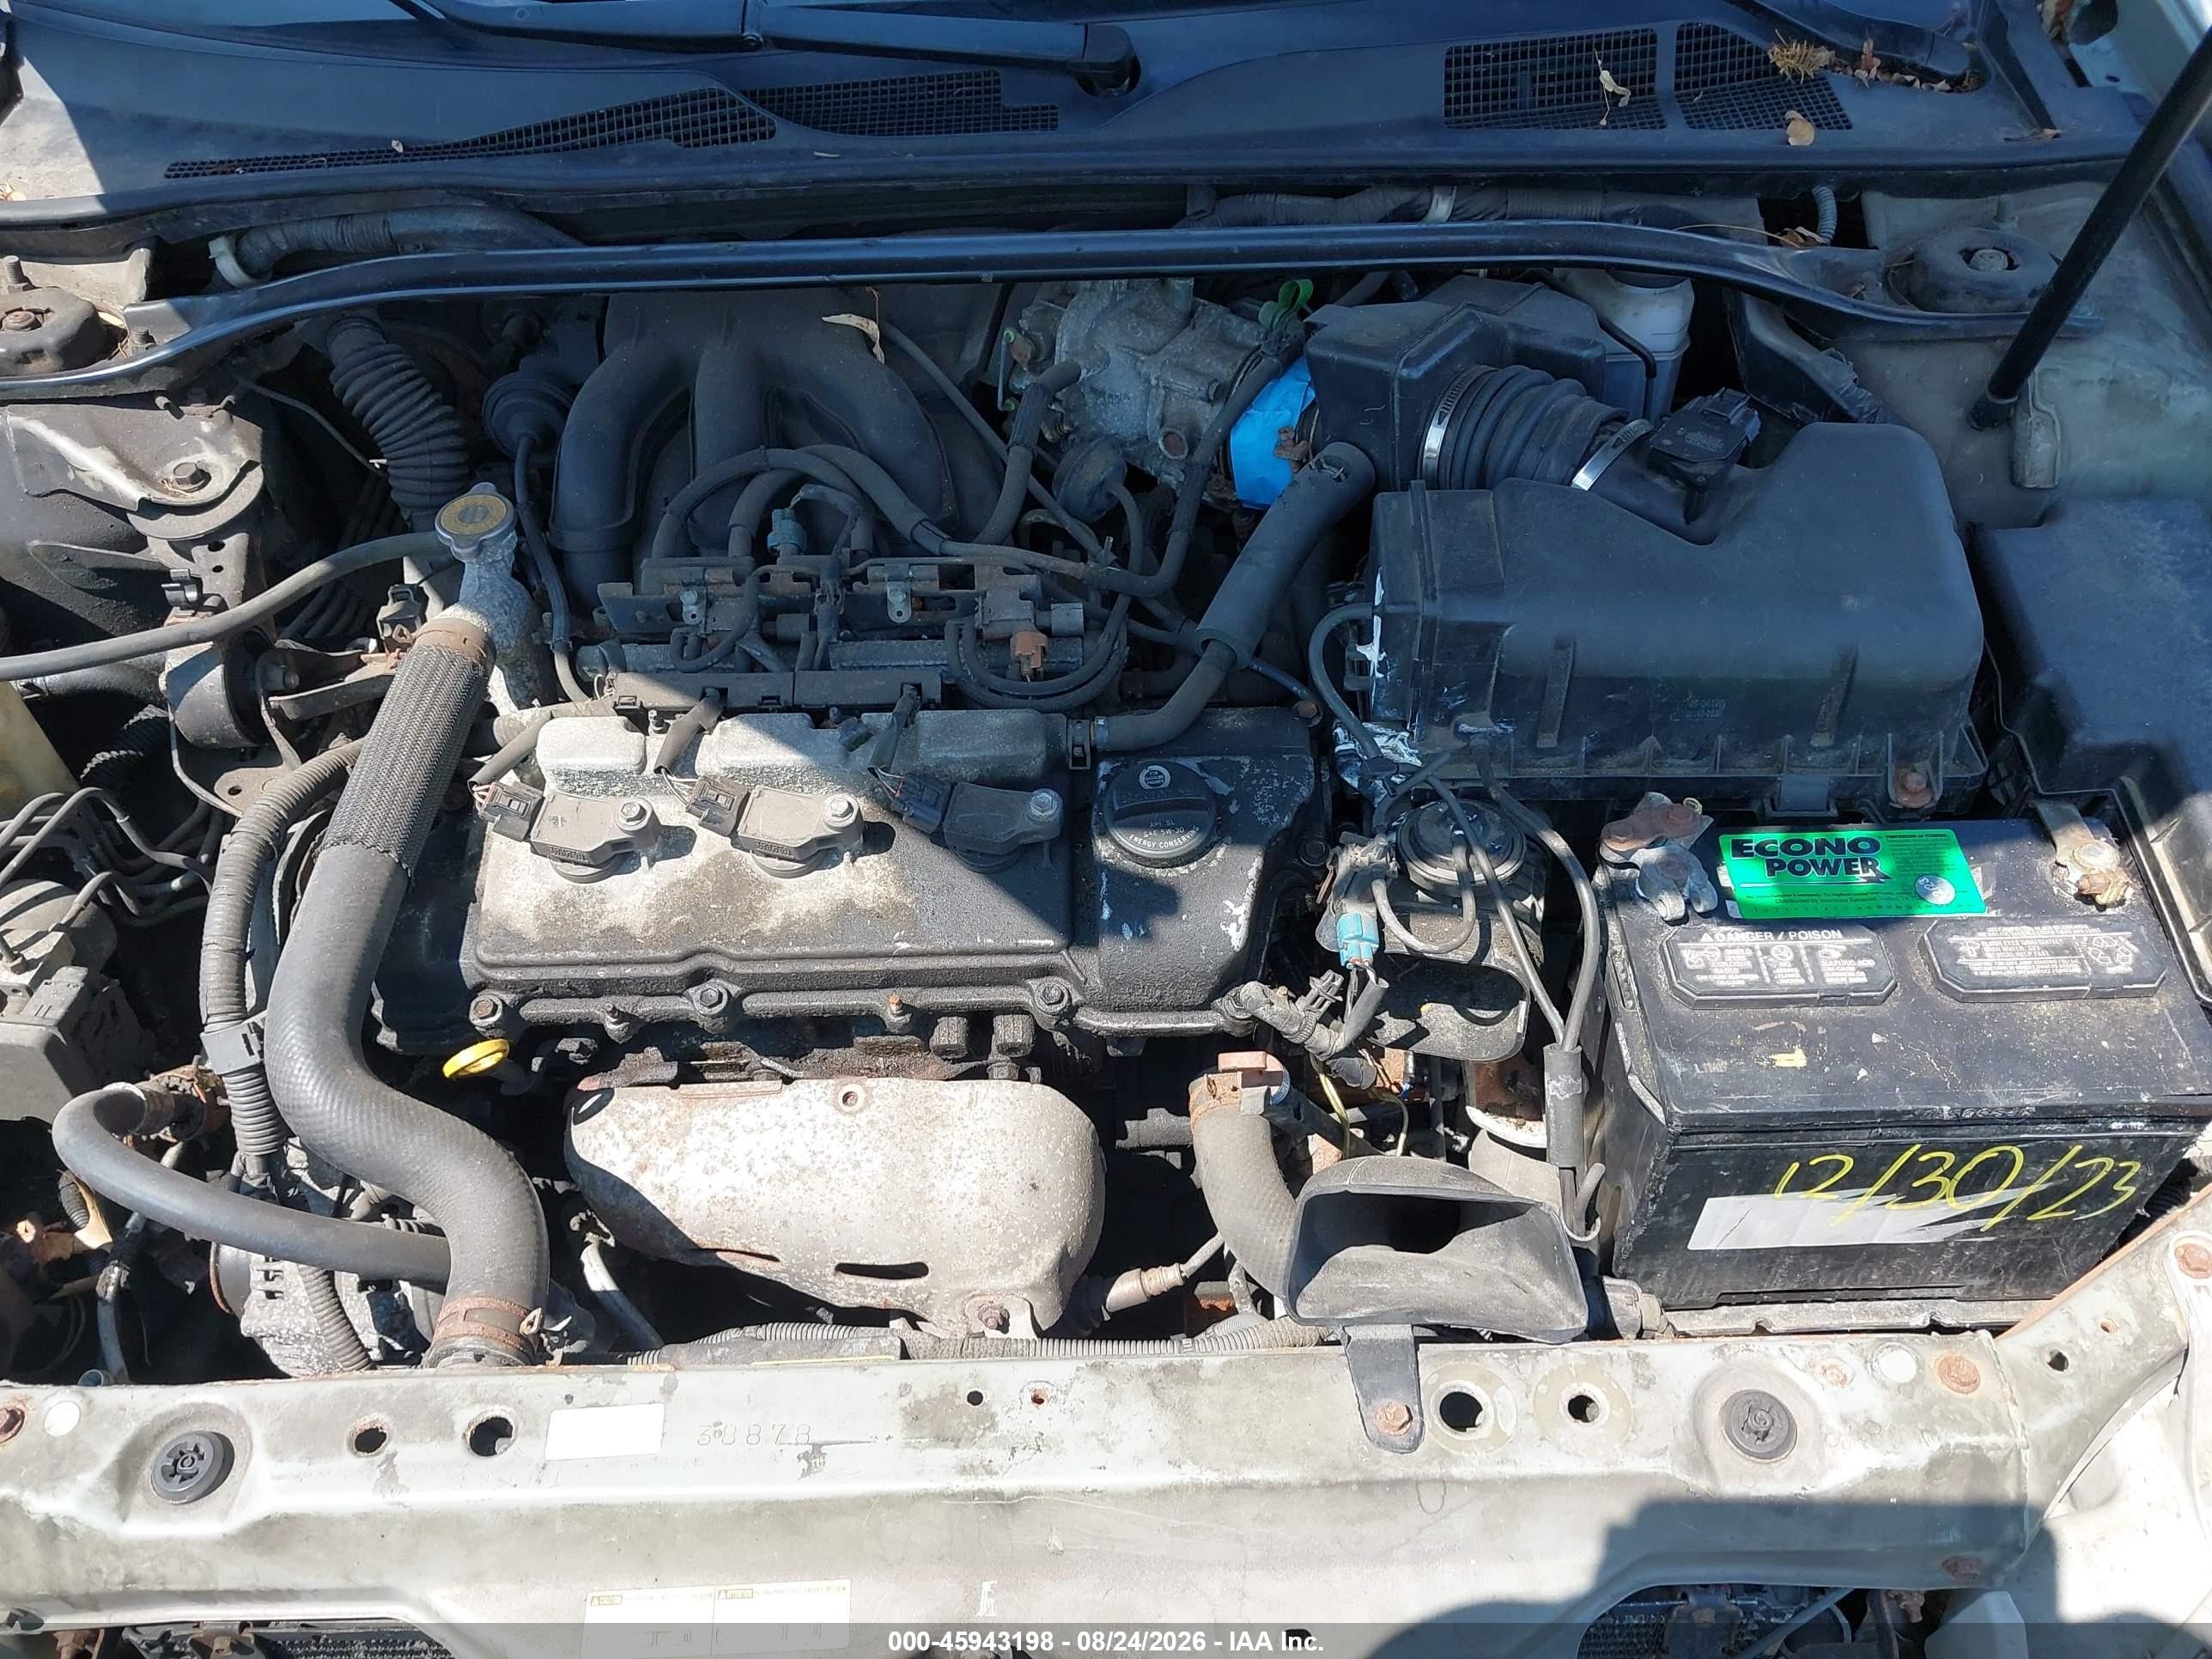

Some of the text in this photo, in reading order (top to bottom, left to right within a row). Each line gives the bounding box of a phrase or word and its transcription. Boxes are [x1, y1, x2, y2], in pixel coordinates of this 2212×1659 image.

[1129, 825, 1200, 848] ENERGY CONSERVING
[1160, 826, 1185, 836] 5W-30
[1730, 836, 1881, 858] ECONO
[1765, 857, 1884, 878] POWER
[1713, 931, 1775, 942] DANGER
[1788, 929, 1844, 941] POISON
[1773, 1143, 2142, 1231] 12/30/23
